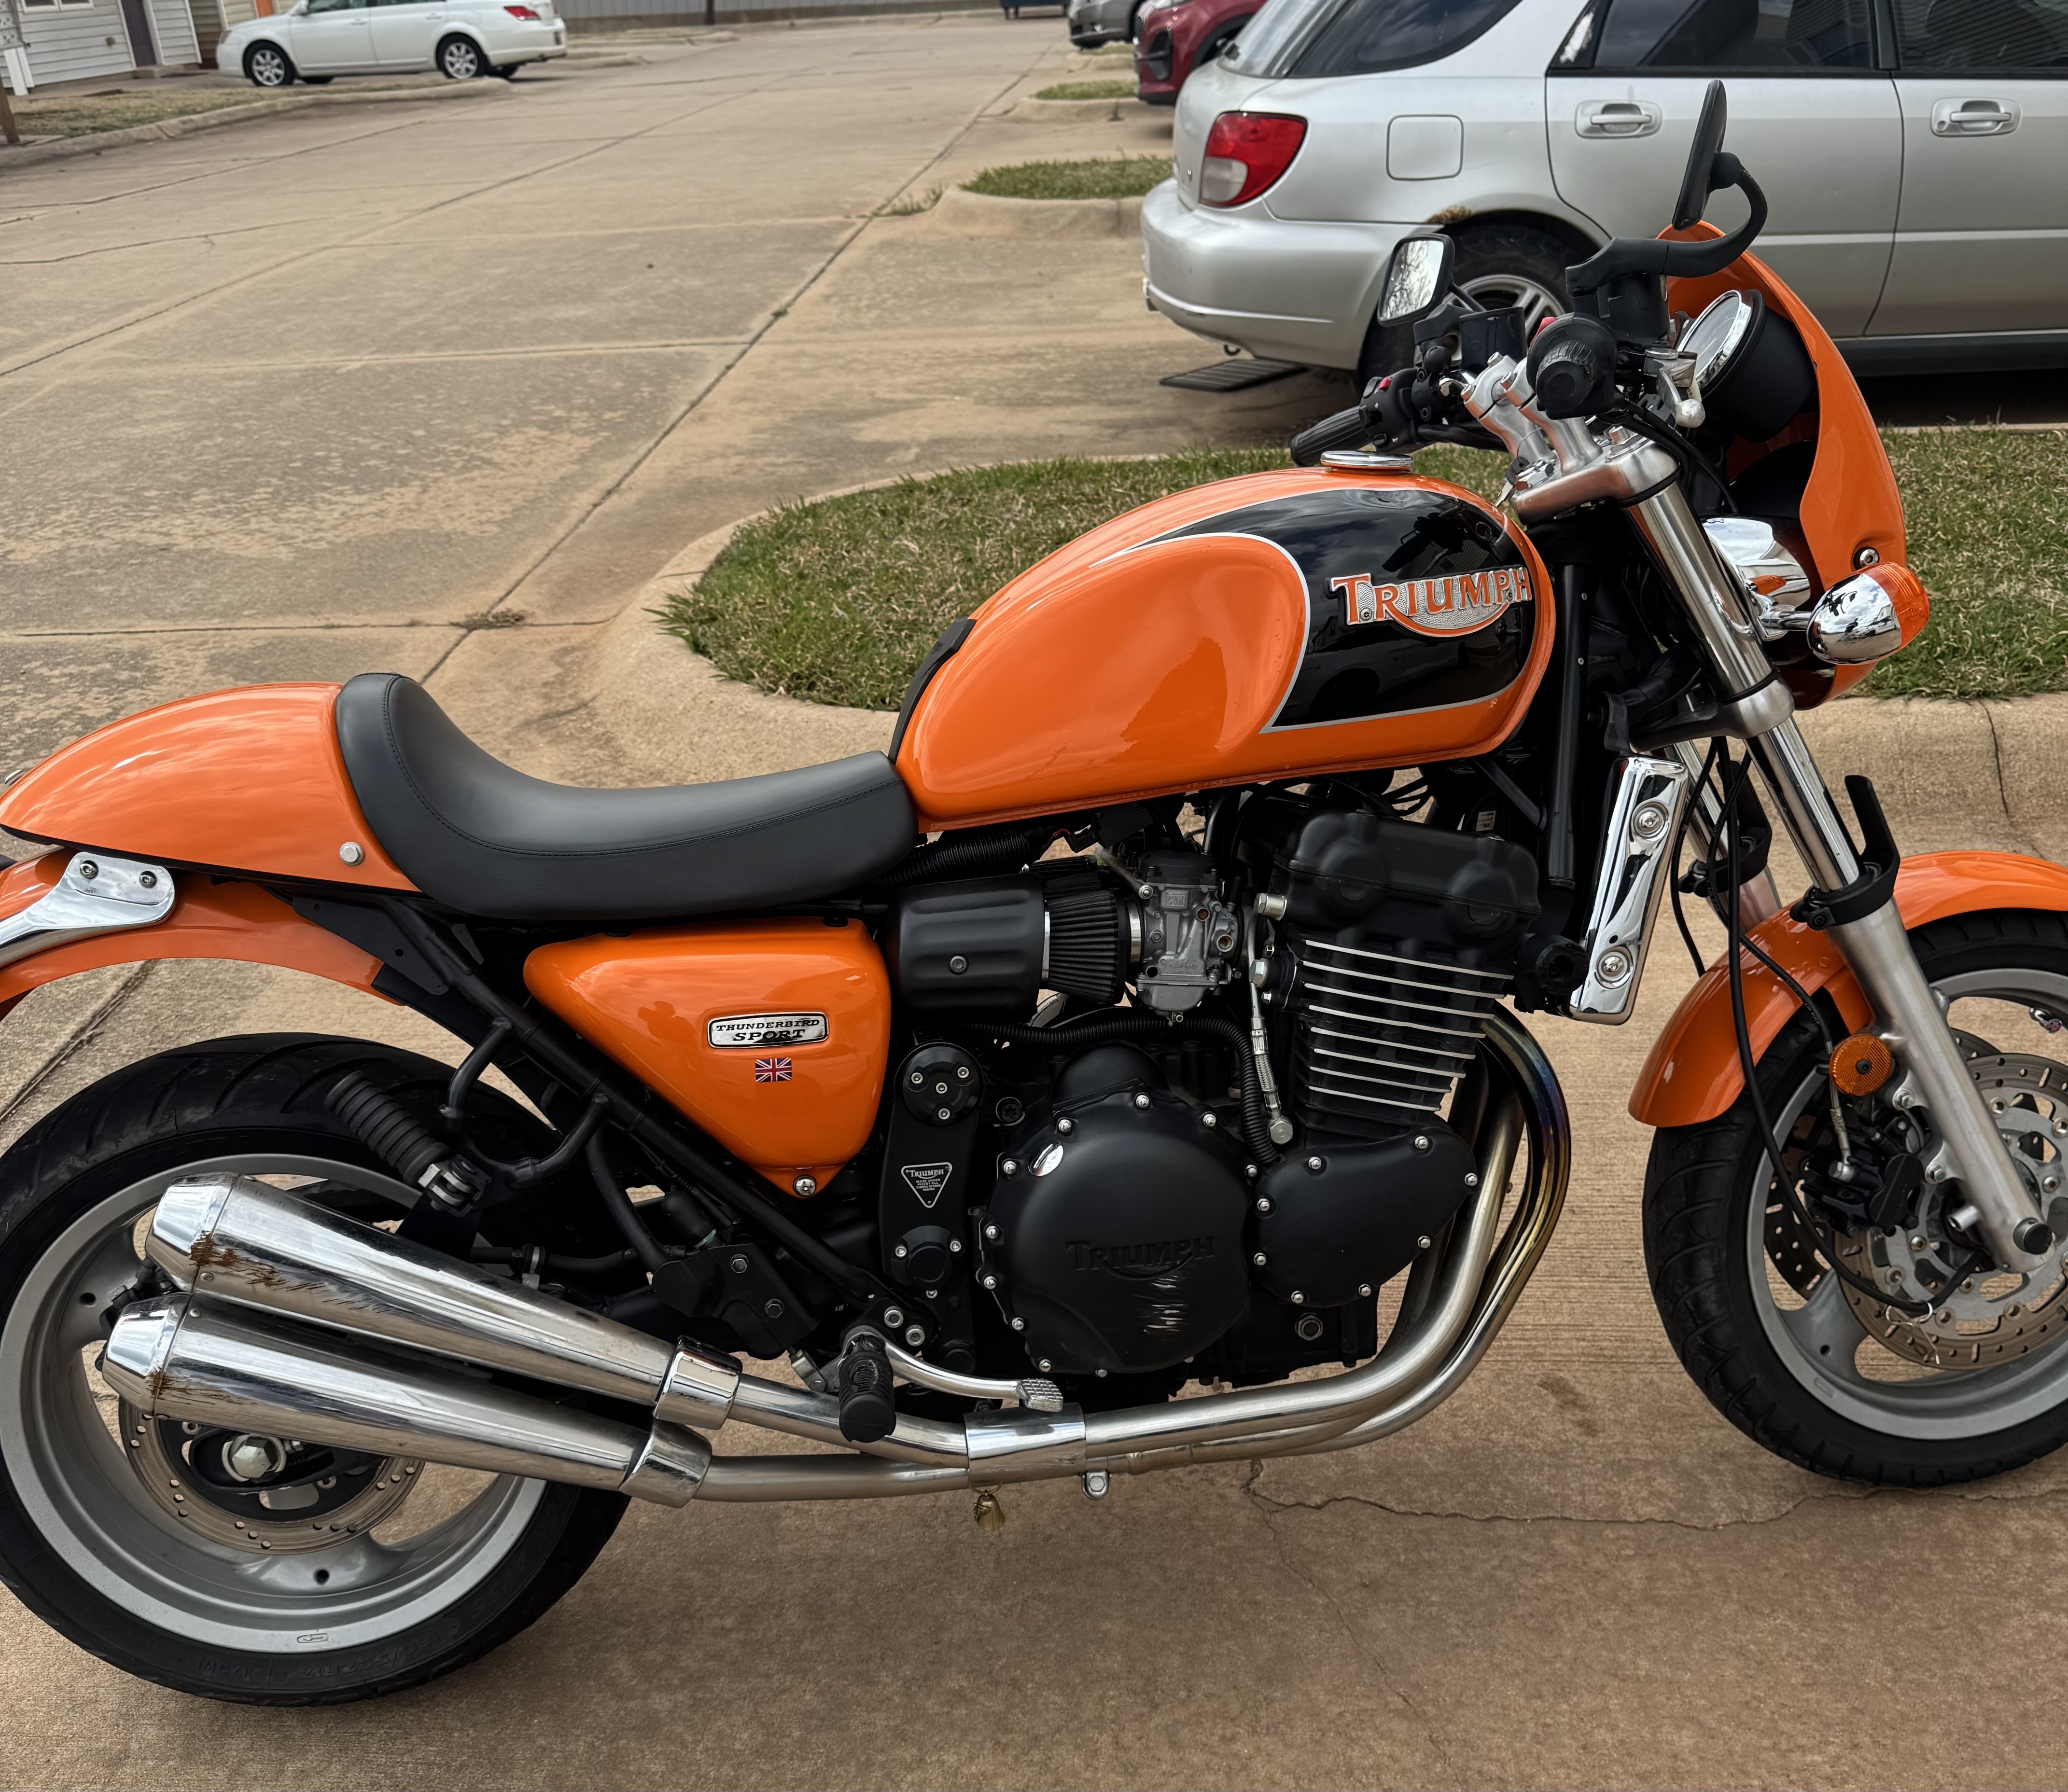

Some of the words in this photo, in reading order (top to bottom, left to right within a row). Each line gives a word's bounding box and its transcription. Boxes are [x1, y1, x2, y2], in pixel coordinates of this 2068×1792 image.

[1331, 567, 1532, 637] TRIUMPH
[716, 1019, 820, 1031] THUNDERBIRD
[733, 1029, 805, 1042] SPORT
[909, 1169, 944, 1179] TRIUMPH
[1066, 1236, 1214, 1280] TRIUMPH
